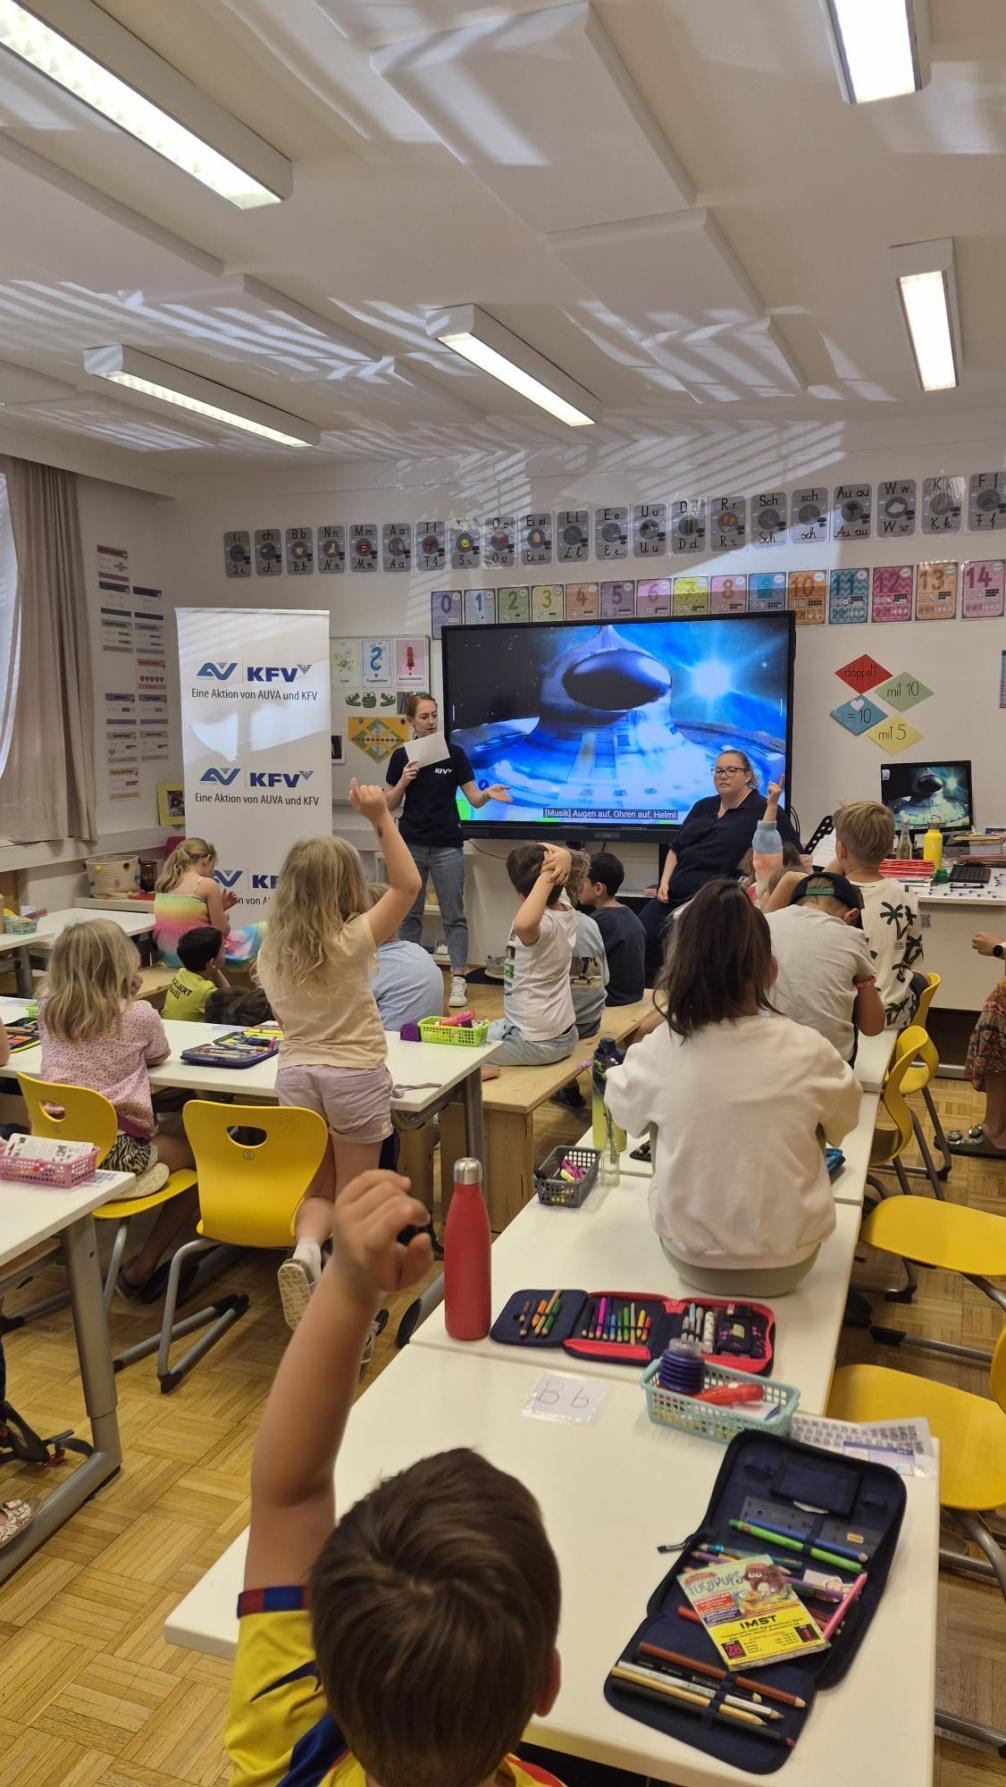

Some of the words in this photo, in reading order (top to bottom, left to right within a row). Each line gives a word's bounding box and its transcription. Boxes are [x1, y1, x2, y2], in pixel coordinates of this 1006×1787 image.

[884, 481, 897, 494] W
[978, 474, 985, 487] F
[801, 490, 818, 501] sch
[837, 486, 852, 499] Au
[857, 488, 869, 497] au
[722, 498, 729, 510] R
[760, 495, 778, 507] Sch
[324, 526, 332, 538] N
[354, 525, 363, 536] M
[390, 524, 397, 535] A
[758, 532, 776, 544] Sch
[832, 572, 855, 596] 11
[876, 572, 900, 594] 12
[919, 569, 945, 590] 13
[966, 566, 992, 588] 14
[612, 585, 623, 604] 5
[648, 583, 658, 603] 6
[685, 581, 696, 601] 7
[723, 579, 733, 599] 8
[791, 576, 815, 597] 10
[441, 594, 452, 614] 0
[475, 593, 482, 612] 1
[508, 591, 518, 610] 2
[542, 590, 552, 608] 3
[576, 587, 588, 607] 4
[247, 667, 298, 682] KFV
[191, 688, 209, 698] Eine
[211, 689, 238, 699] Aktion
[240, 691, 256, 700] von
[258, 690, 281, 700] AUVA
[283, 690, 300, 700] und
[301, 691, 318, 701] KFV
[887, 683, 902, 697] mit
[906, 681, 919, 696] 10
[859, 708, 872, 723] 10
[878, 726, 893, 740] mit
[896, 724, 907, 740] 5
[250, 772, 300, 788] KFV
[195, 793, 213, 803] Eine
[214, 793, 241, 804] Aktion
[243, 796, 258, 804] von
[260, 795, 283, 805] AUVA
[285, 796, 301, 805] und
[303, 796, 319, 806] KFV
[544, 808, 571, 819] [Musik]
[573, 810, 596, 819] Augen
[613, 810, 636, 819] Ohren
[654, 811, 677, 819] Helmi
[246, 897, 261, 905] von
[536, 1380, 565, 1404] B
[740, 1615, 777, 1630] IMST
